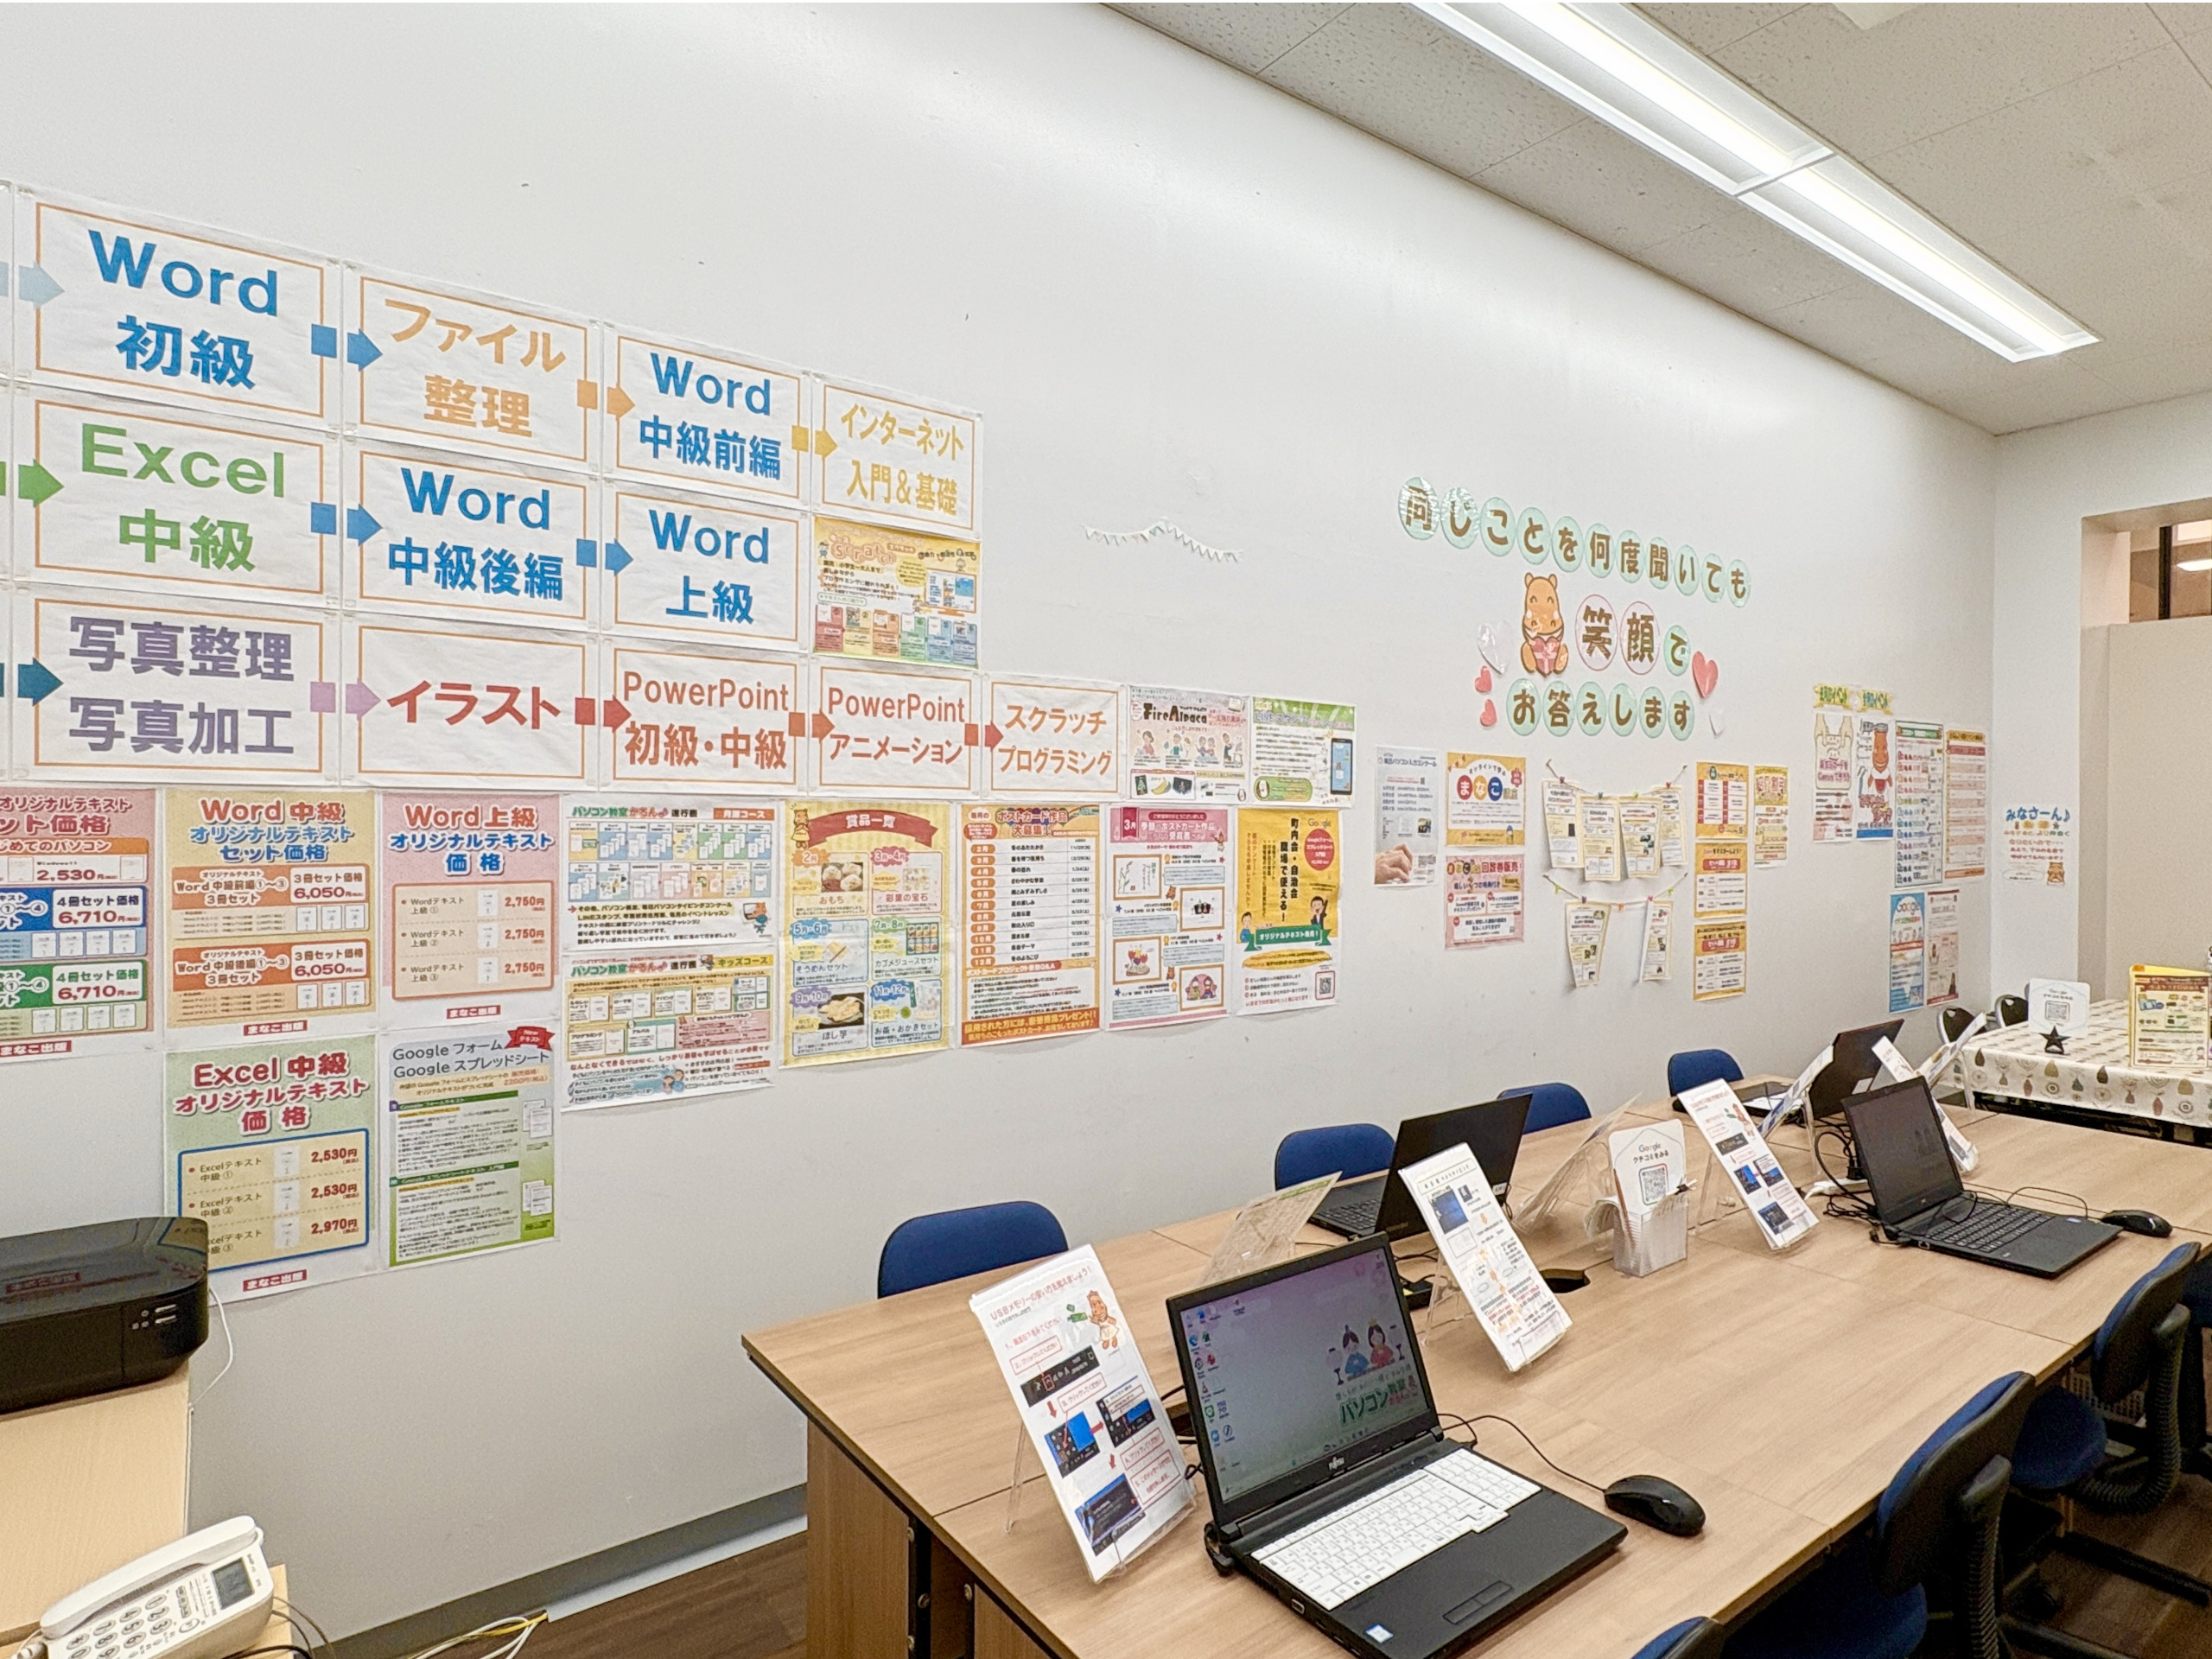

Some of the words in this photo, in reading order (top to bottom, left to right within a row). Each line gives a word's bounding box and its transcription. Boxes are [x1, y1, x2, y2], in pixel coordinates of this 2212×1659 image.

[88, 229, 277, 316] Word
[116, 315, 256, 390] 初級
[385, 297, 566, 372] ファイル
[650, 353, 771, 416] Word
[423, 375, 532, 436] 整理
[639, 415, 781, 480] 中級前編
[840, 404, 964, 461] インターネット
[82, 423, 284, 498] Excel
[400, 467, 550, 530] Word
[118, 508, 256, 572] 中級
[648, 508, 769, 564] Word
[388, 537, 563, 601] 中級後編
[665, 575, 753, 625] 上級
[69, 616, 294, 682] 写真整理
[1582, 604, 1687, 666] 笑顔で
[387, 680, 561, 729] イラスト
[624, 671, 789, 712] PowerPoint
[829, 687, 964, 722] PowerPoint
[69, 696, 294, 754] 写真加工
[1006, 704, 1106, 735] スクラッチ
[1513, 690, 1690, 732] お答えします
[625, 721, 786, 770] 初級・中級
[829, 731, 963, 765] アニメーション
[1000, 747, 1112, 777] プログラミング
[0, 797, 132, 812] オリジナルテキスト
[200, 799, 283, 821] Word
[997, 810, 1068, 821] ポストカード作品
[1308, 818, 1332, 829] Gogle
[190, 826, 353, 842] オリジナルテキスト
[220, 844, 327, 861] セット価格
[391, 834, 553, 849] オリジナルテキスト
[203, 949, 263, 958] オリジナルテキスト
[718, 957, 768, 966] キッズコース
[796, 963, 848, 973] そうめんセット
[874, 957, 938, 968] カゴメジュースセット
[393, 1045, 449, 1060] Google
[453, 1039, 502, 1054] フォーム
[394, 1062, 450, 1078] Google
[454, 1052, 550, 1071] スプレッドシート
[194, 1058, 277, 1087] Excel
[288, 1052, 347, 1079] 中級
[175, 1079, 368, 1113] オリジナルテキスト
[1341, 1390, 1388, 1424] パソコン
